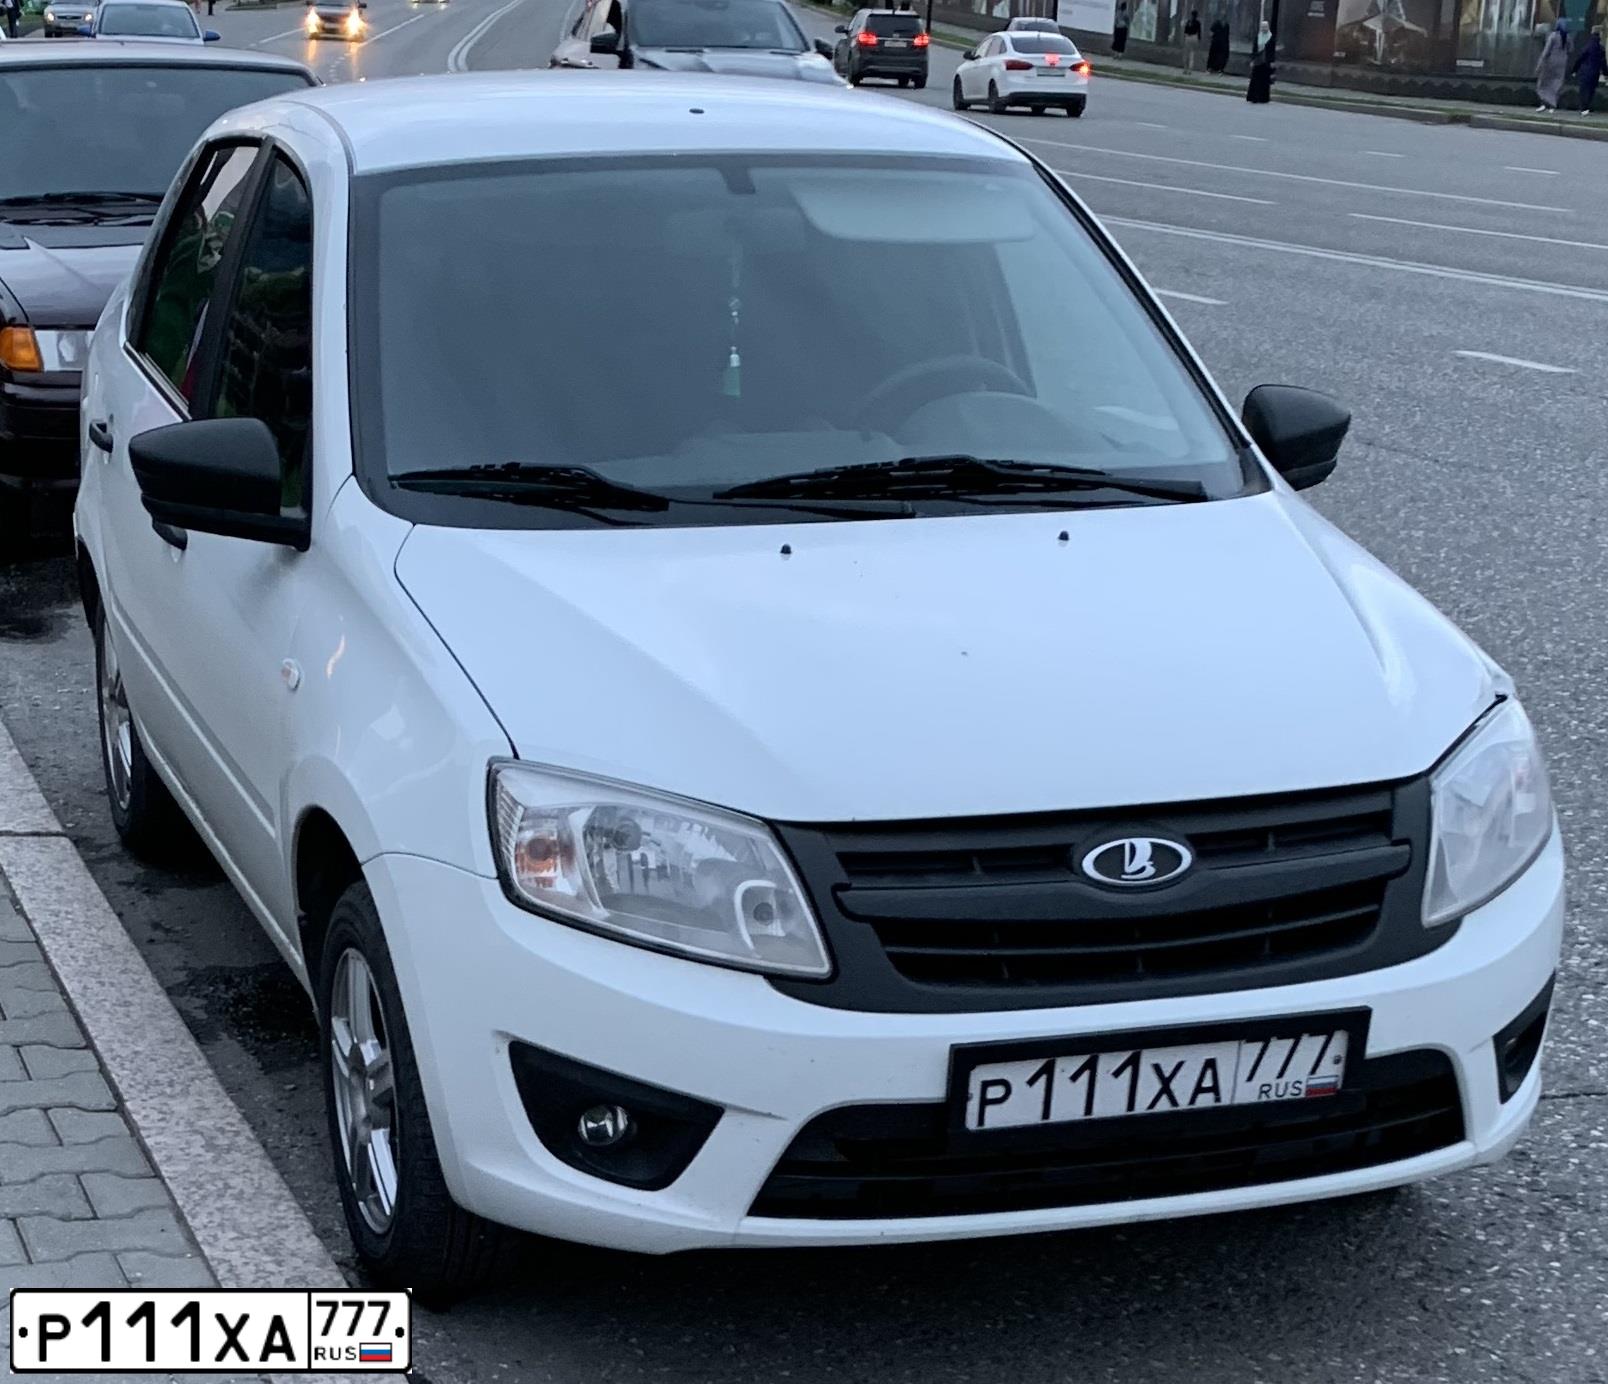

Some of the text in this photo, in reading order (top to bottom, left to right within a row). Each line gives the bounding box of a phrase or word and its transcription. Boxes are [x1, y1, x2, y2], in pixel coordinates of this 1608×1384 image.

[976, 1030, 1336, 1128] P111XA 777
[1258, 1080, 1303, 1100] RUS
